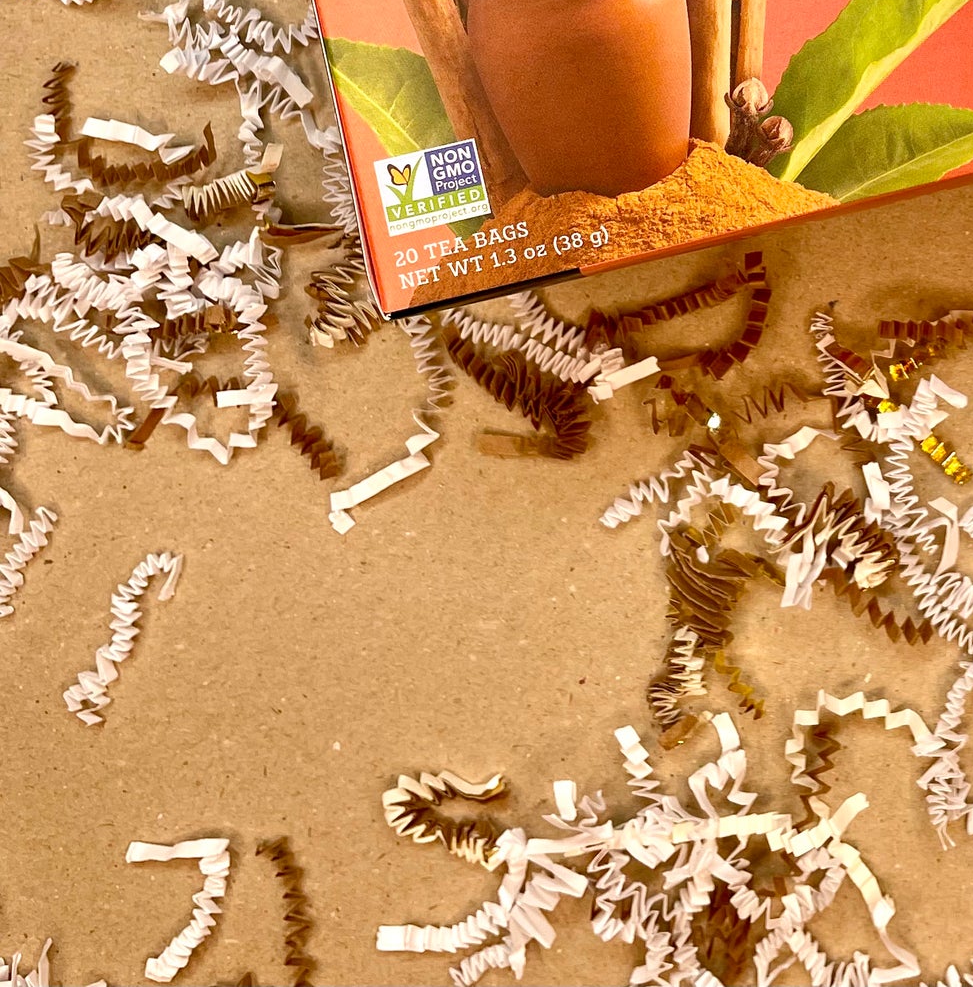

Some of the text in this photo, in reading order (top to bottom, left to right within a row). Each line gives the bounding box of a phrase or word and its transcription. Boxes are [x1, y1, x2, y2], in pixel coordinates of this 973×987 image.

[430, 145, 472, 167] NON
[432, 159, 475, 181] GMO
[435, 175, 478, 192] Project
[389, 202, 489, 231] nongmoproject.org
[391, 190, 481, 219] VERIFIED
[394, 222, 529, 268] 20 TEA BAGS
[399, 225, 610, 289] NET WT 1.3 oz (38 g)
